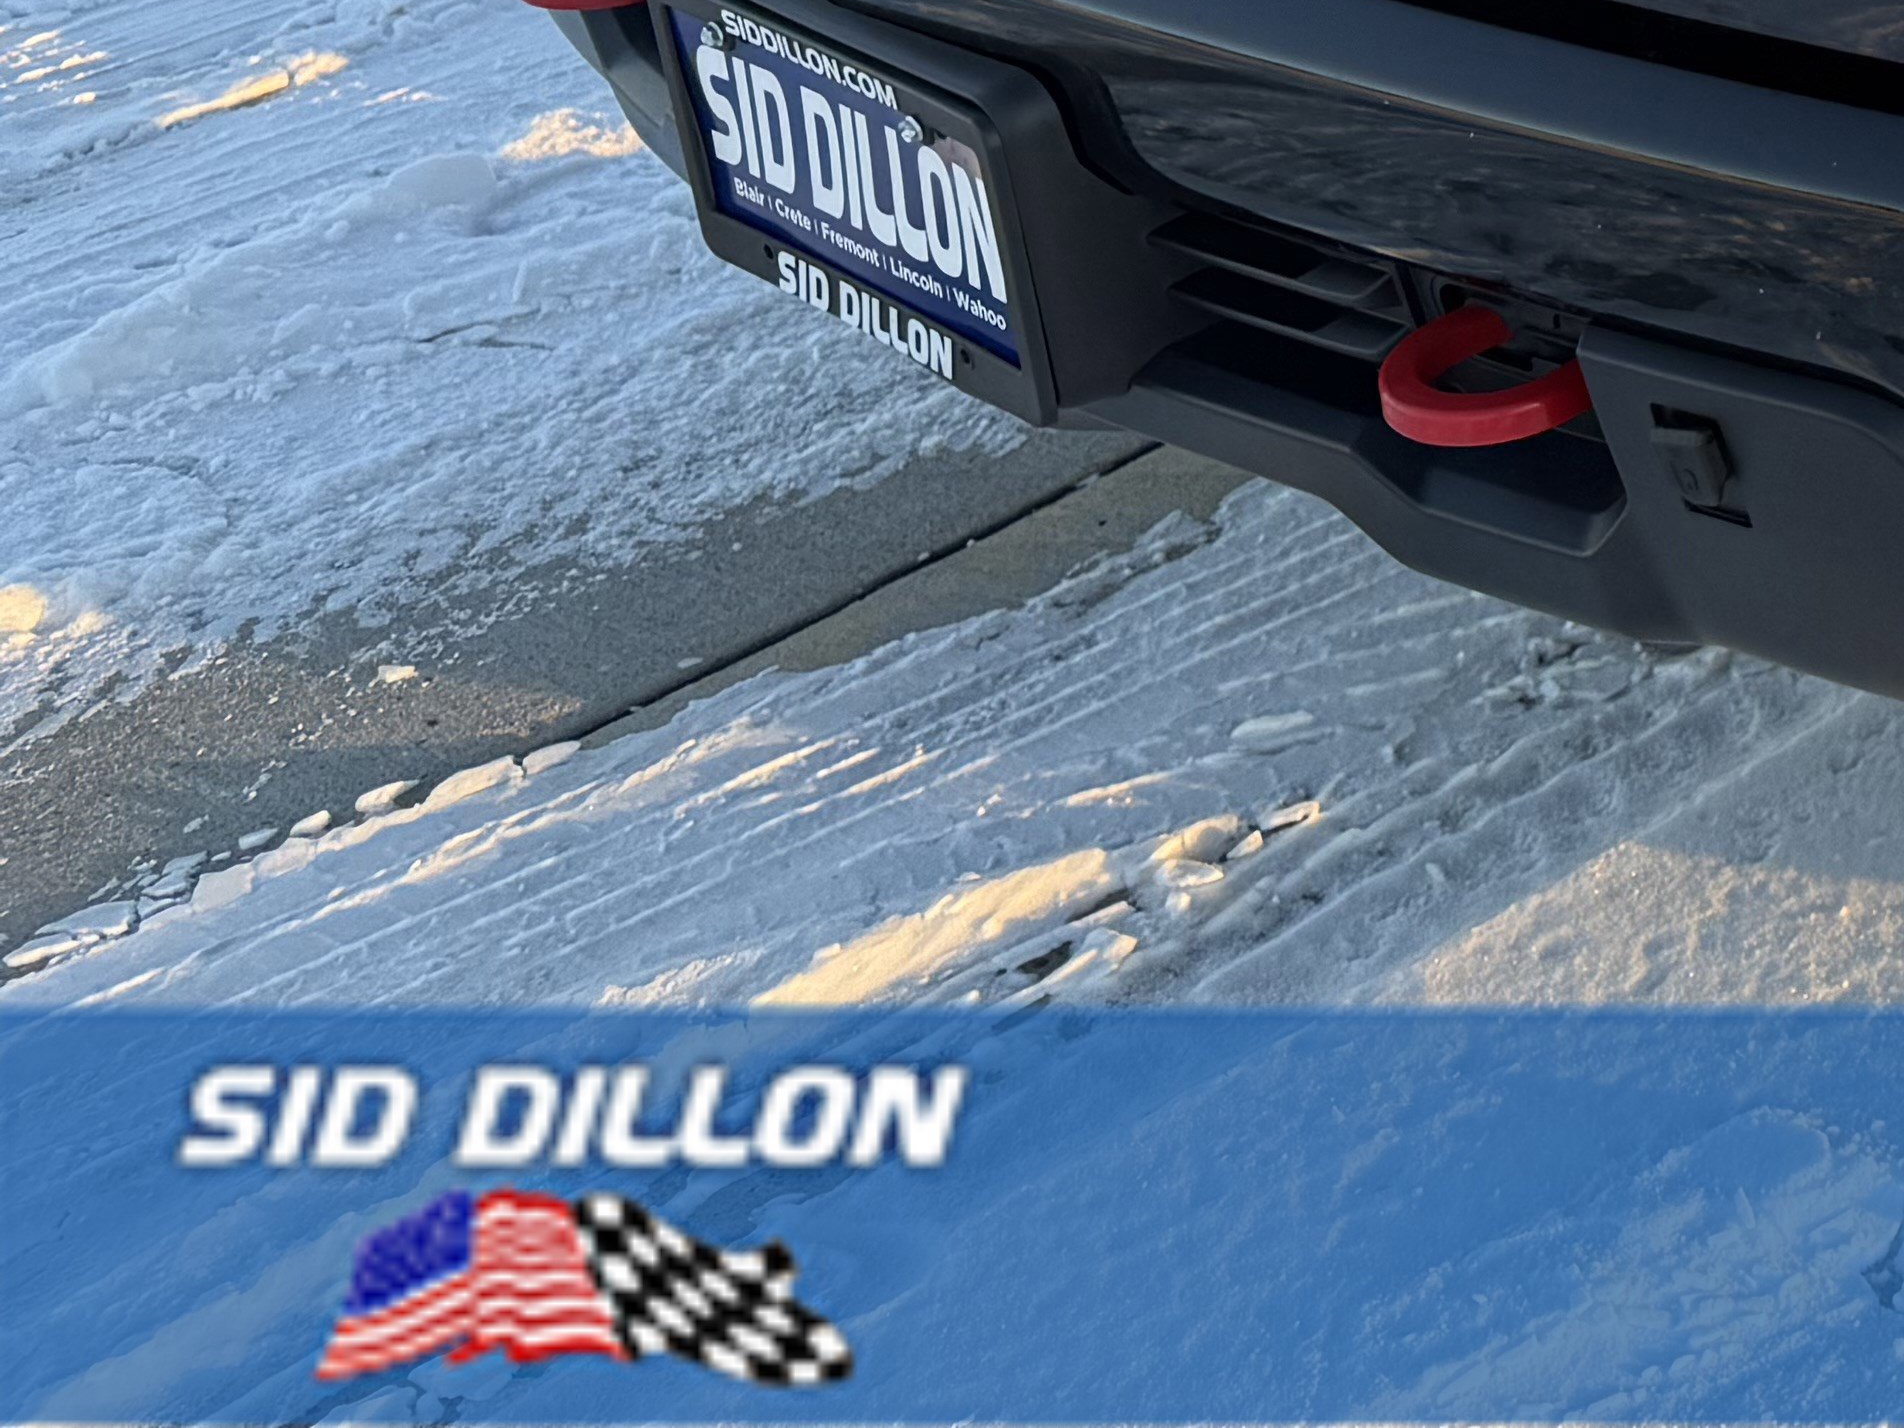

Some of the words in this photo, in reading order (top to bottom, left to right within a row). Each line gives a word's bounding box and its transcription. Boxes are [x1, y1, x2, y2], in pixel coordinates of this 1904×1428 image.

[720, 8, 899, 112] SIDDILLON.COM
[697, 44, 797, 195] SID
[799, 84, 1008, 304] DILLON
[733, 176, 766, 206] Blair
[774, 197, 812, 232] Crete
[820, 222, 880, 268] Fremont
[889, 255, 944, 299] Lincoln
[952, 289, 1007, 332] Wahoo
[777, 250, 831, 313] SID
[838, 279, 954, 381] DILLON
